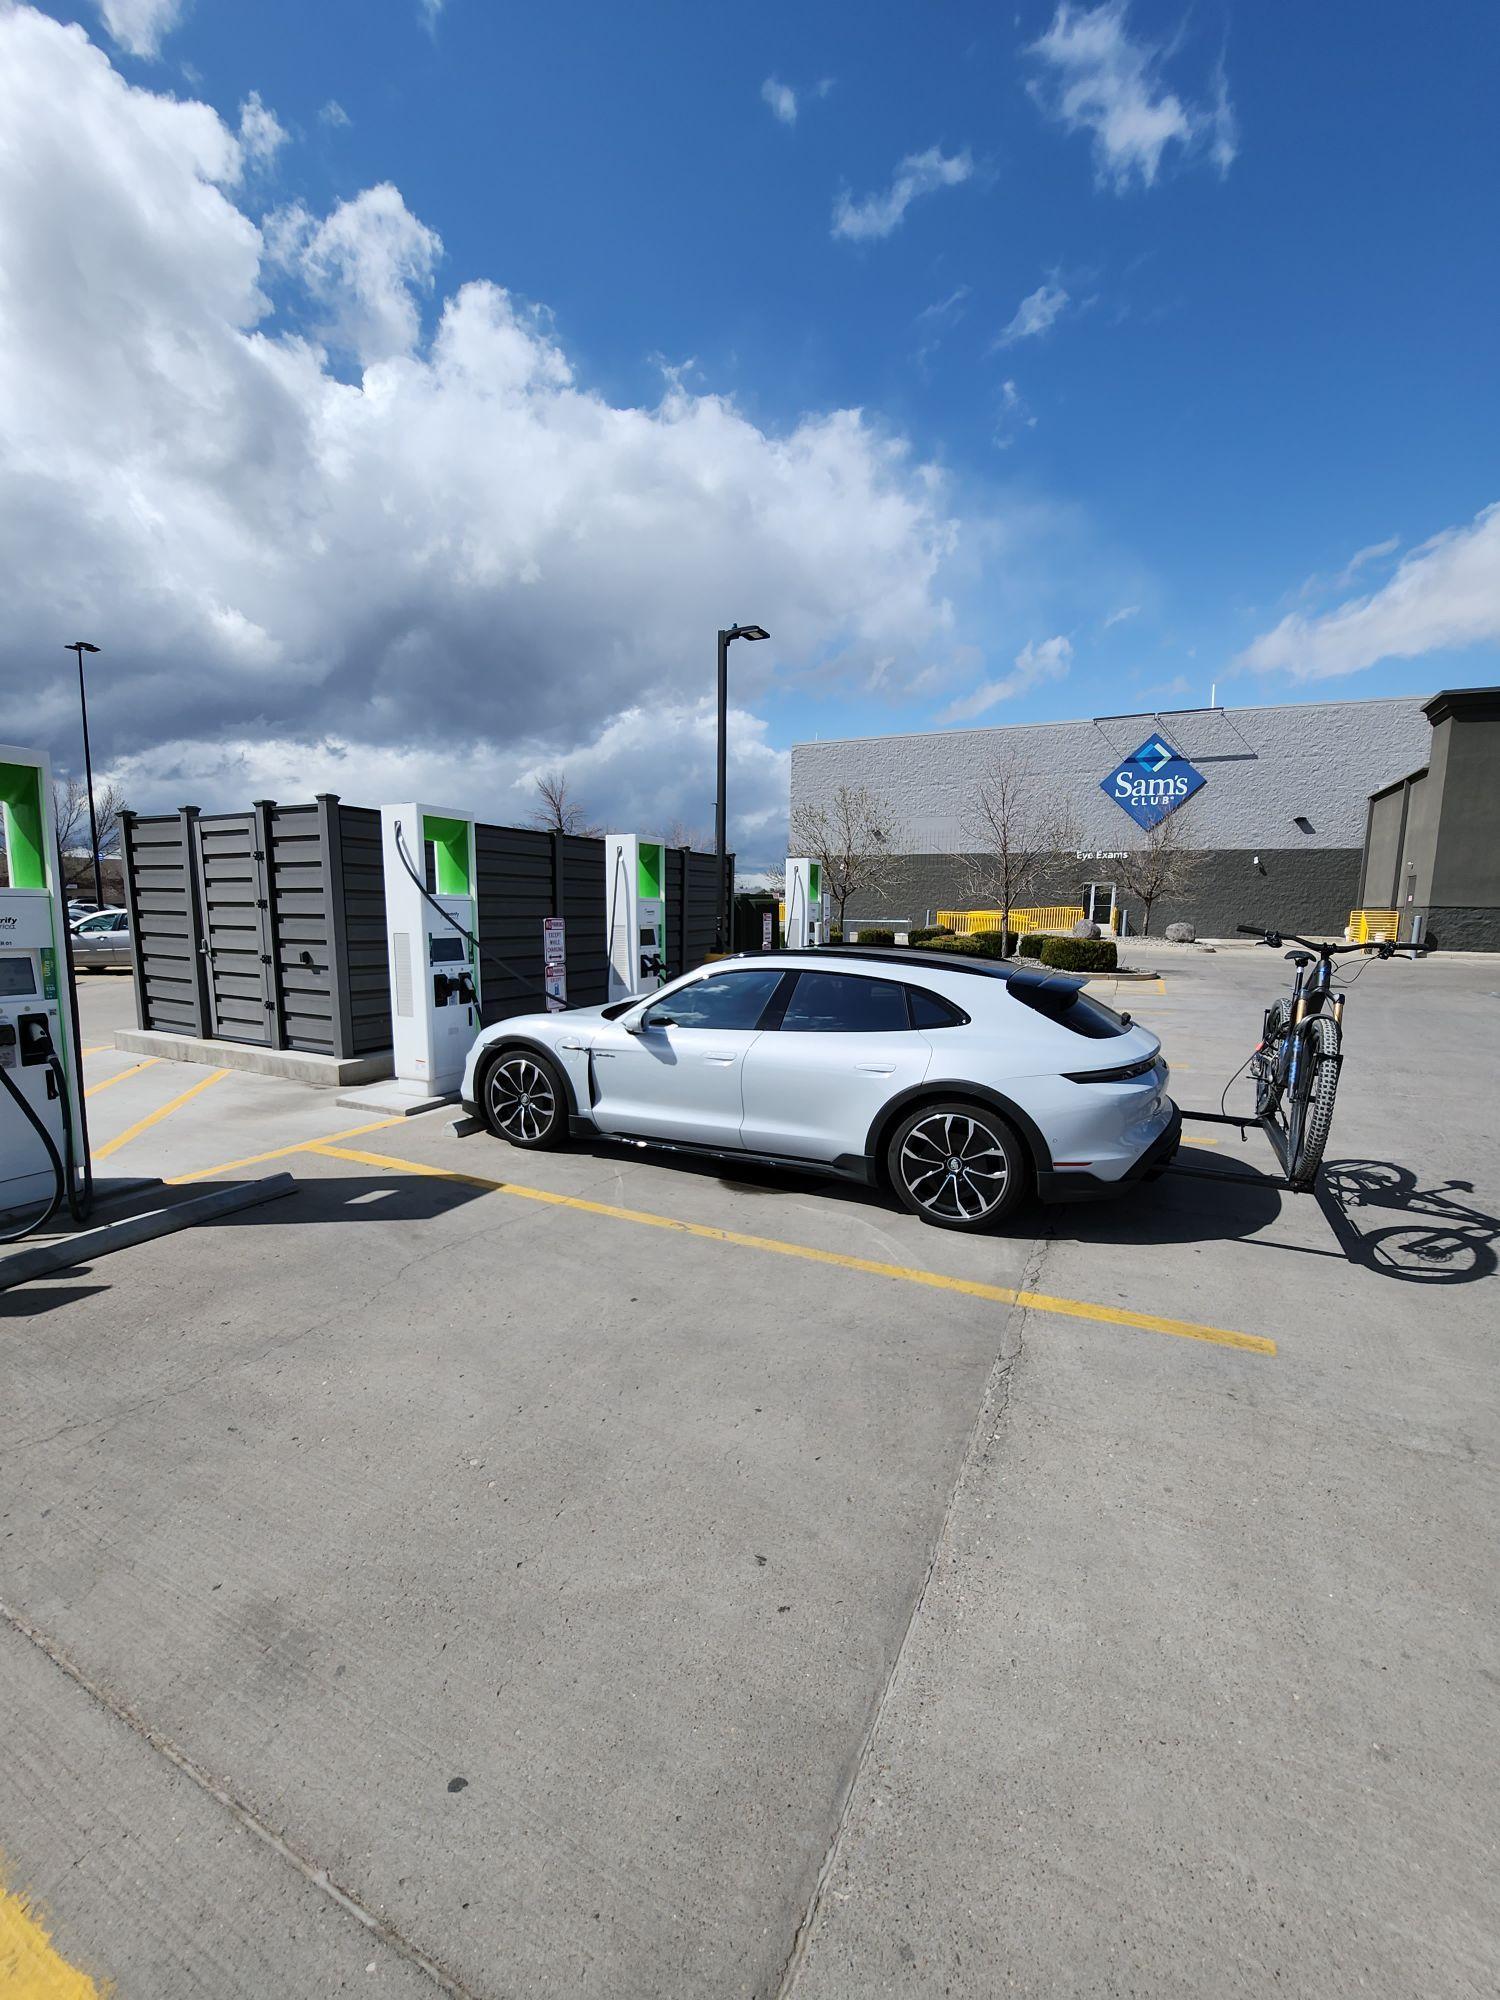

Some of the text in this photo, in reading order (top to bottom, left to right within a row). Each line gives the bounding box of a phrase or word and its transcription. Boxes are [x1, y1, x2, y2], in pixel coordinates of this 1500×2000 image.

[1115, 771, 1188, 798] Sam's
[1131, 796, 1170, 806] CLUB
[1076, 850, 1129, 861] Eye Exams
